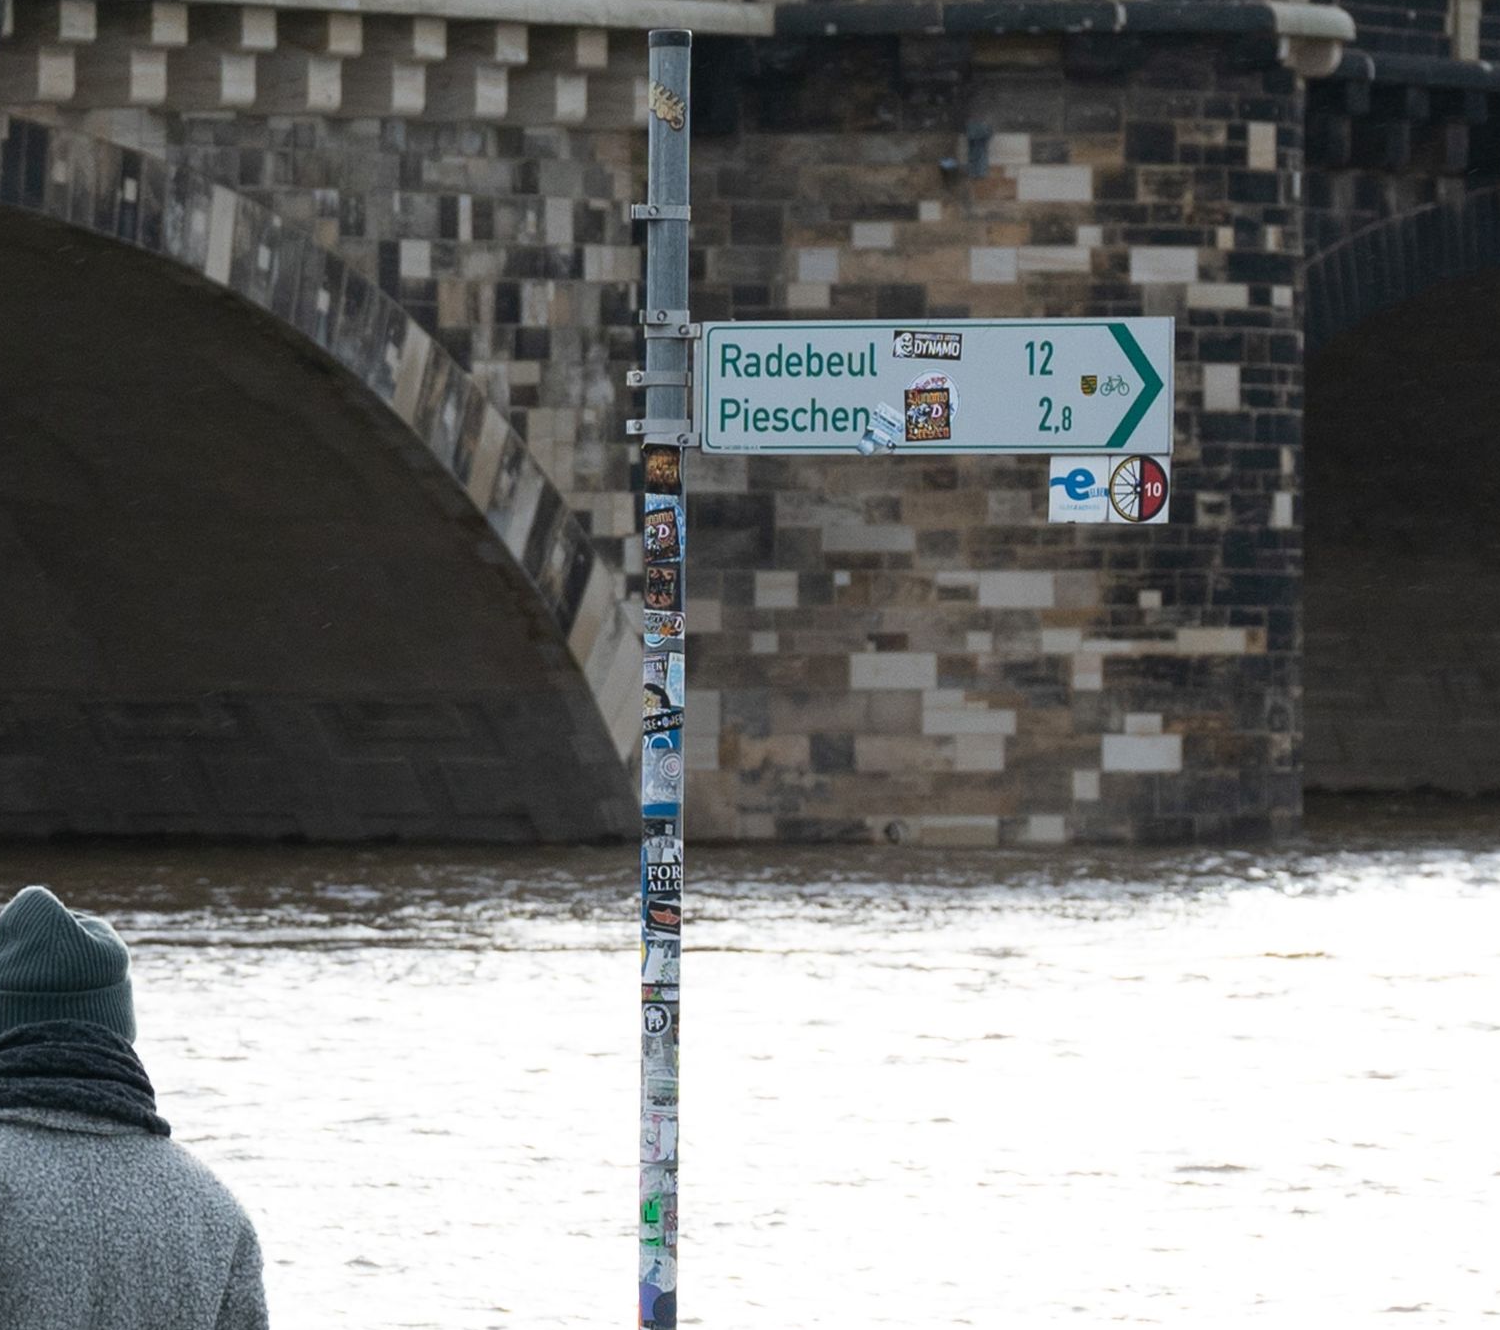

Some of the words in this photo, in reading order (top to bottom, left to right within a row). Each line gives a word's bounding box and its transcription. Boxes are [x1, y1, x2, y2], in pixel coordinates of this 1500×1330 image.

[914, 339, 960, 356] DYNAMO
[720, 343, 878, 377] Radebeul
[1025, 340, 1054, 375] 12
[720, 397, 870, 433] Pieschen
[1038, 396, 1073, 435] 2,8
[1144, 481, 1162, 497] 10
[648, 864, 681, 880] FOR
[648, 880, 673, 891] ALL
